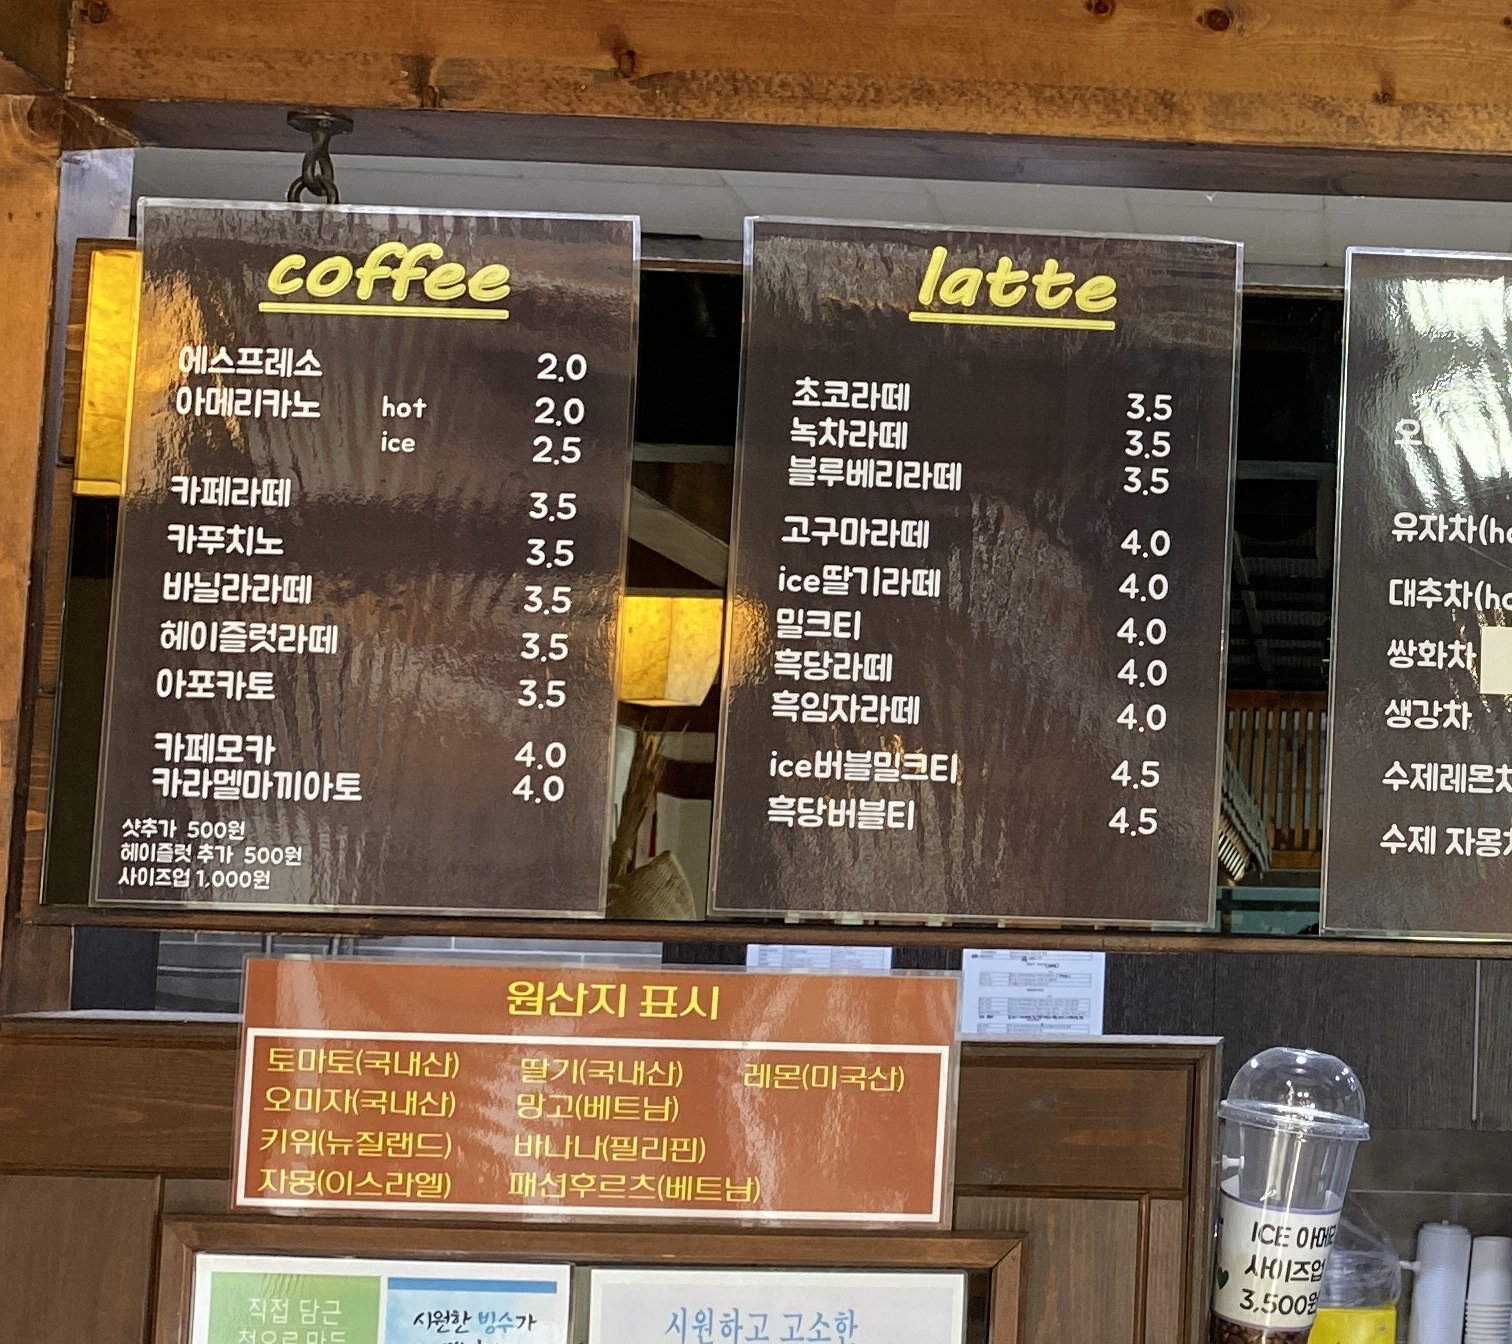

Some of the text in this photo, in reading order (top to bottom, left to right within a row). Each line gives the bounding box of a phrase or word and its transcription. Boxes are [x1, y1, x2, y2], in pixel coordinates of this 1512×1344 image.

[267, 242, 511, 302] coffee
[918, 246, 1118, 313] latte
[178, 346, 587, 381] 에스프레소 2.0
[175, 388, 427, 419] 아메리카노 hot
[381, 433, 582, 464] ice 2.5
[790, 418, 907, 450] 녹차라떼
[788, 456, 962, 492] 블루베리라떼
[170, 477, 290, 509] 카페라떼
[163, 574, 313, 604] 바닐라라떼
[778, 566, 941, 598] ice딸기라떼
[160, 621, 338, 654] 헤이즐럿라떼
[776, 610, 861, 639] 밀크티
[773, 651, 892, 683] 흑당라떼
[1387, 640, 1475, 670] 쌍화차
[156, 671, 275, 702] 아포카토
[771, 690, 920, 724] 흑임자라떼
[1384, 701, 1472, 731] 생강차
[154, 734, 275, 764] 카페모카
[769, 751, 958, 784] ice버블밀크티
[151, 768, 362, 802] 카라멜마끼아토
[122, 819, 245, 840] 샷추가 500원
[767, 796, 1158, 835] 흑당버블티 4.5
[120, 843, 302, 866] 헤이즐럿 추가 500원
[1380, 825, 1435, 855] 수제
[118, 868, 270, 889] 사이즈업 1,000원
[506, 980, 721, 1021] 원산지 표시
[267, 1048, 906, 1094] 토마토(국내산) 딸기(국내산) 레몬(미국산)
[263, 1087, 680, 1123] 오미자(국내산) 망고(베트남)
[259, 1127, 707, 1165] 키위(뉴질랜드) 바나나(필리핀)
[257, 1167, 760, 1205] 자몽(이스라엘) 패션후르츠(베트남)
[1251, 1221, 1291, 1247] ICE
[249, 1299, 342, 1324] 직접 담근
[414, 1311, 537, 1334] 시원한 빙수가
